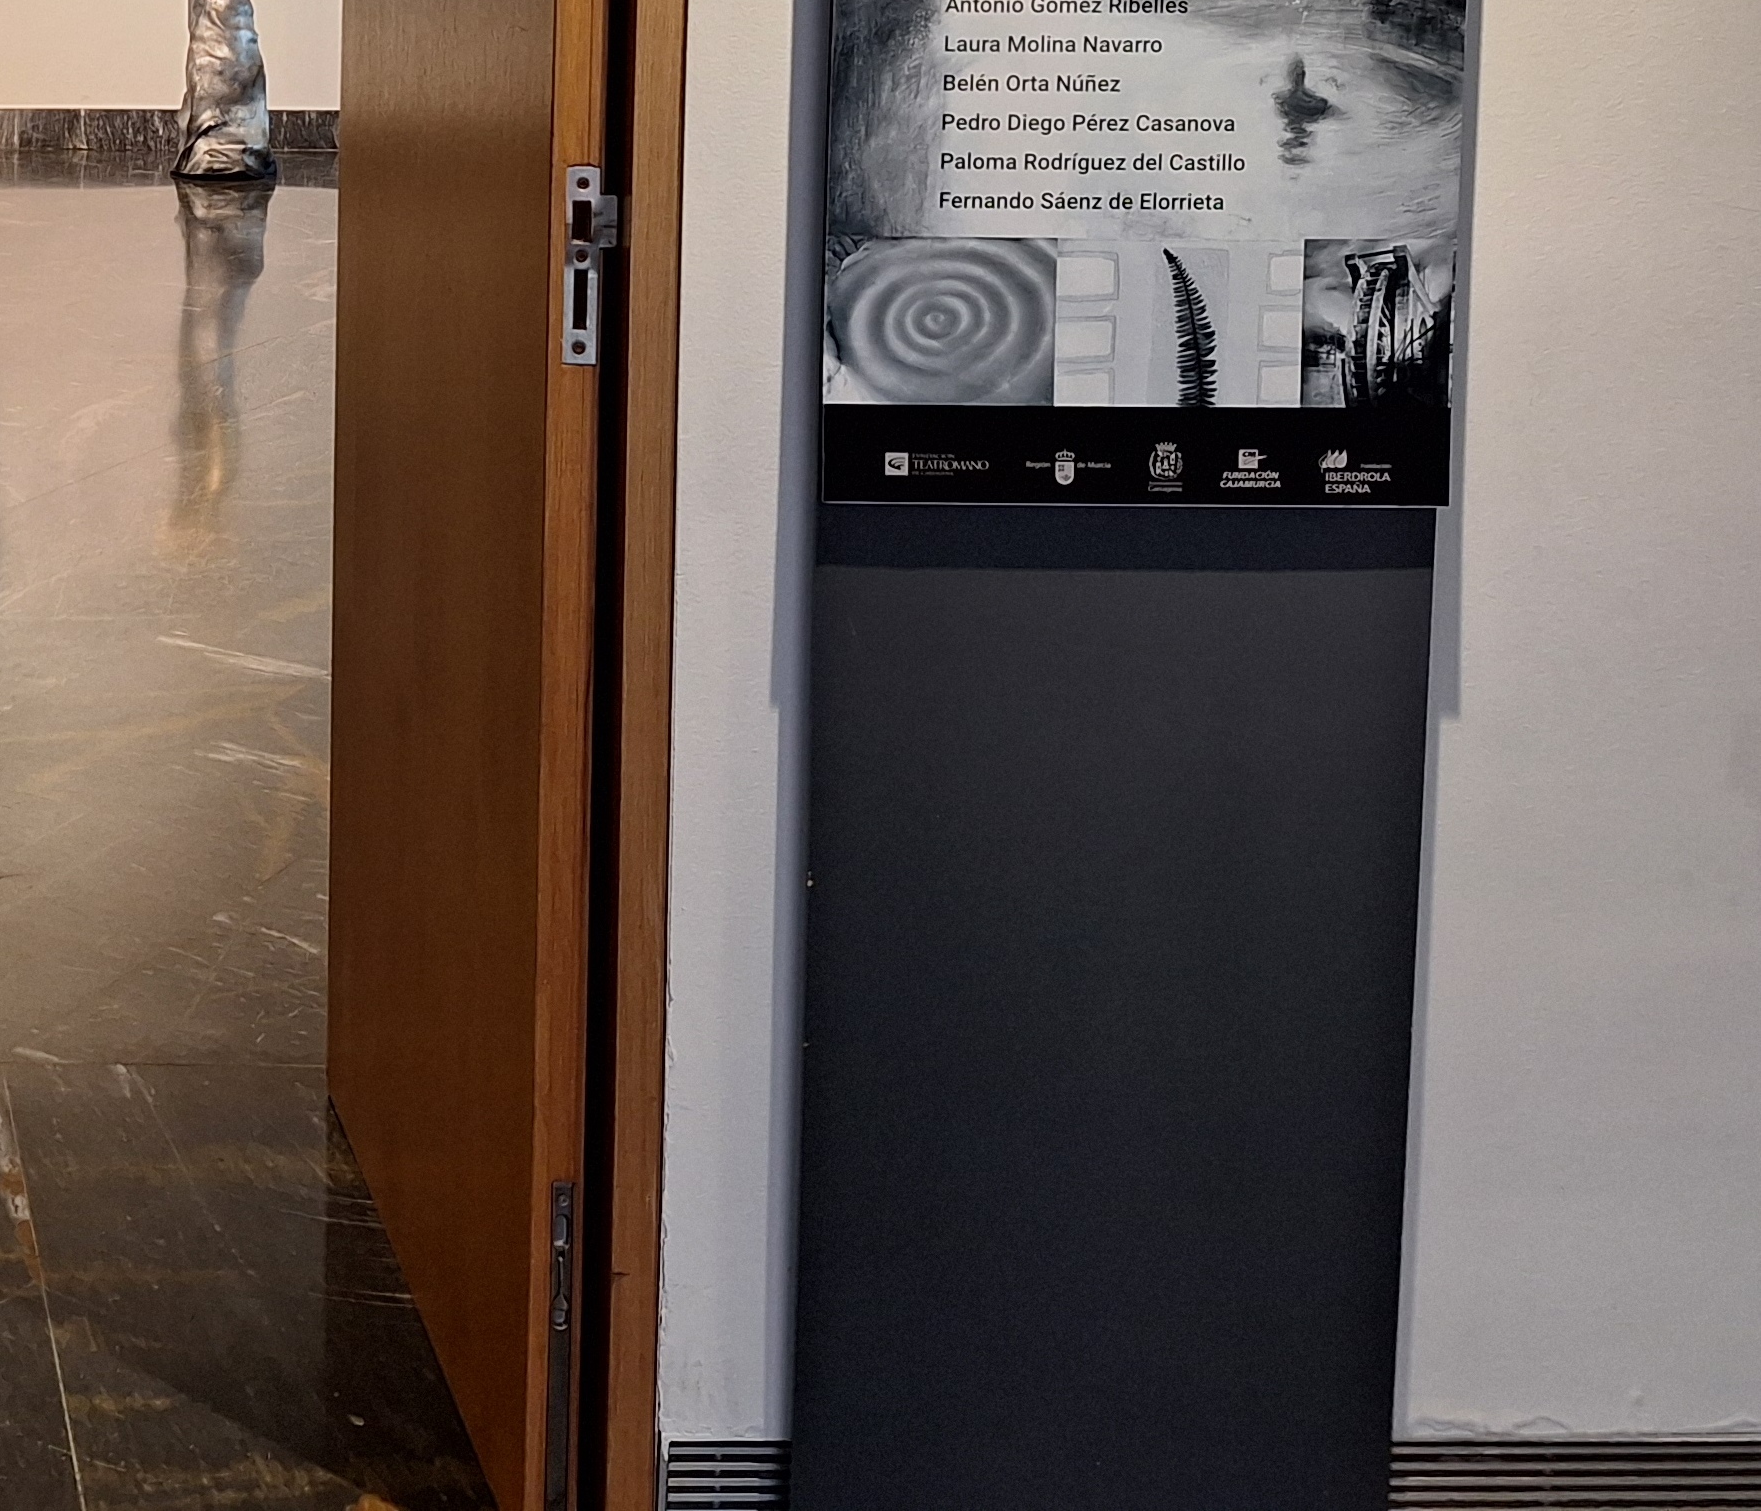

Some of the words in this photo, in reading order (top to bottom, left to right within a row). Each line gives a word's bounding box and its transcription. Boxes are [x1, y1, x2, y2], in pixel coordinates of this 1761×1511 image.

[944, 36, 1002, 54] Laura
[1007, 35, 1077, 54] Molina
[1083, 35, 1163, 54] Navarro
[943, 74, 1000, 93] Belén
[1006, 74, 1051, 93] Orta
[1056, 73, 1121, 93] Núñez
[942, 113, 1001, 133] Pedro
[1007, 113, 1066, 135] Diego
[1072, 113, 1130, 133] Pérez
[1136, 114, 1236, 133] Casanova
[940, 152, 1017, 172] Paloma
[1024, 152, 1126, 174] Rodríguez
[1132, 152, 1163, 172] del
[1169, 153, 1246, 173] Castillo
[939, 191, 1035, 210] Fernando
[1041, 191, 1103, 210] Sáenz
[1108, 191, 1134, 211] de
[1140, 192, 1225, 212] Elorrieta
[1220, 480, 1281, 488] CAJAMURCIA
[1223, 470, 1279, 479] FUNDACIÓN
[1325, 472, 1391, 481] IBERDROLA
[1325, 482, 1371, 493] ESPAÑA
